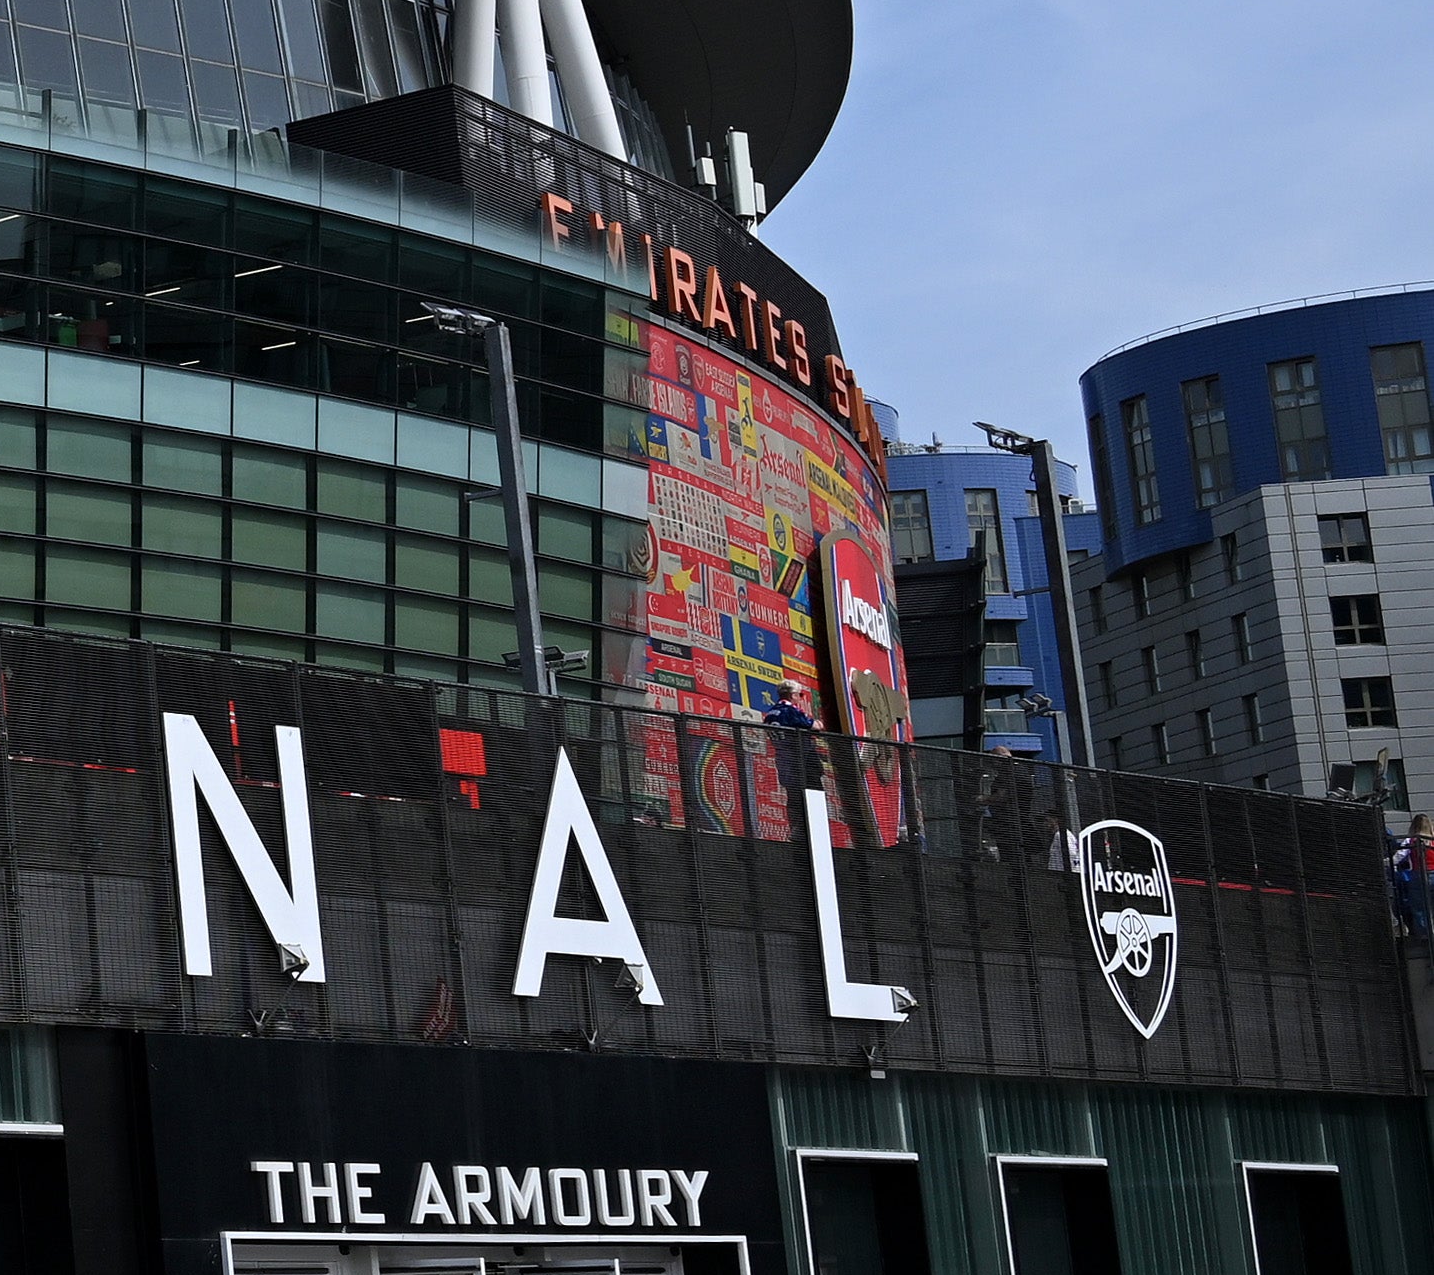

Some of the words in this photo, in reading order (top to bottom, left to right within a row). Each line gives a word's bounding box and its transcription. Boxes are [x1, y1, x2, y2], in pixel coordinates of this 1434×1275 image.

[749, 600, 790, 630] GUNNERS
[841, 579, 892, 651] Arsenal
[726, 654, 757, 673] ARSENAL
[757, 665, 783, 681] SWEDEN
[1094, 861, 1162, 897] Arsenal
[251, 1160, 385, 1224] THE
[411, 1162, 710, 1227] ARMOURY
